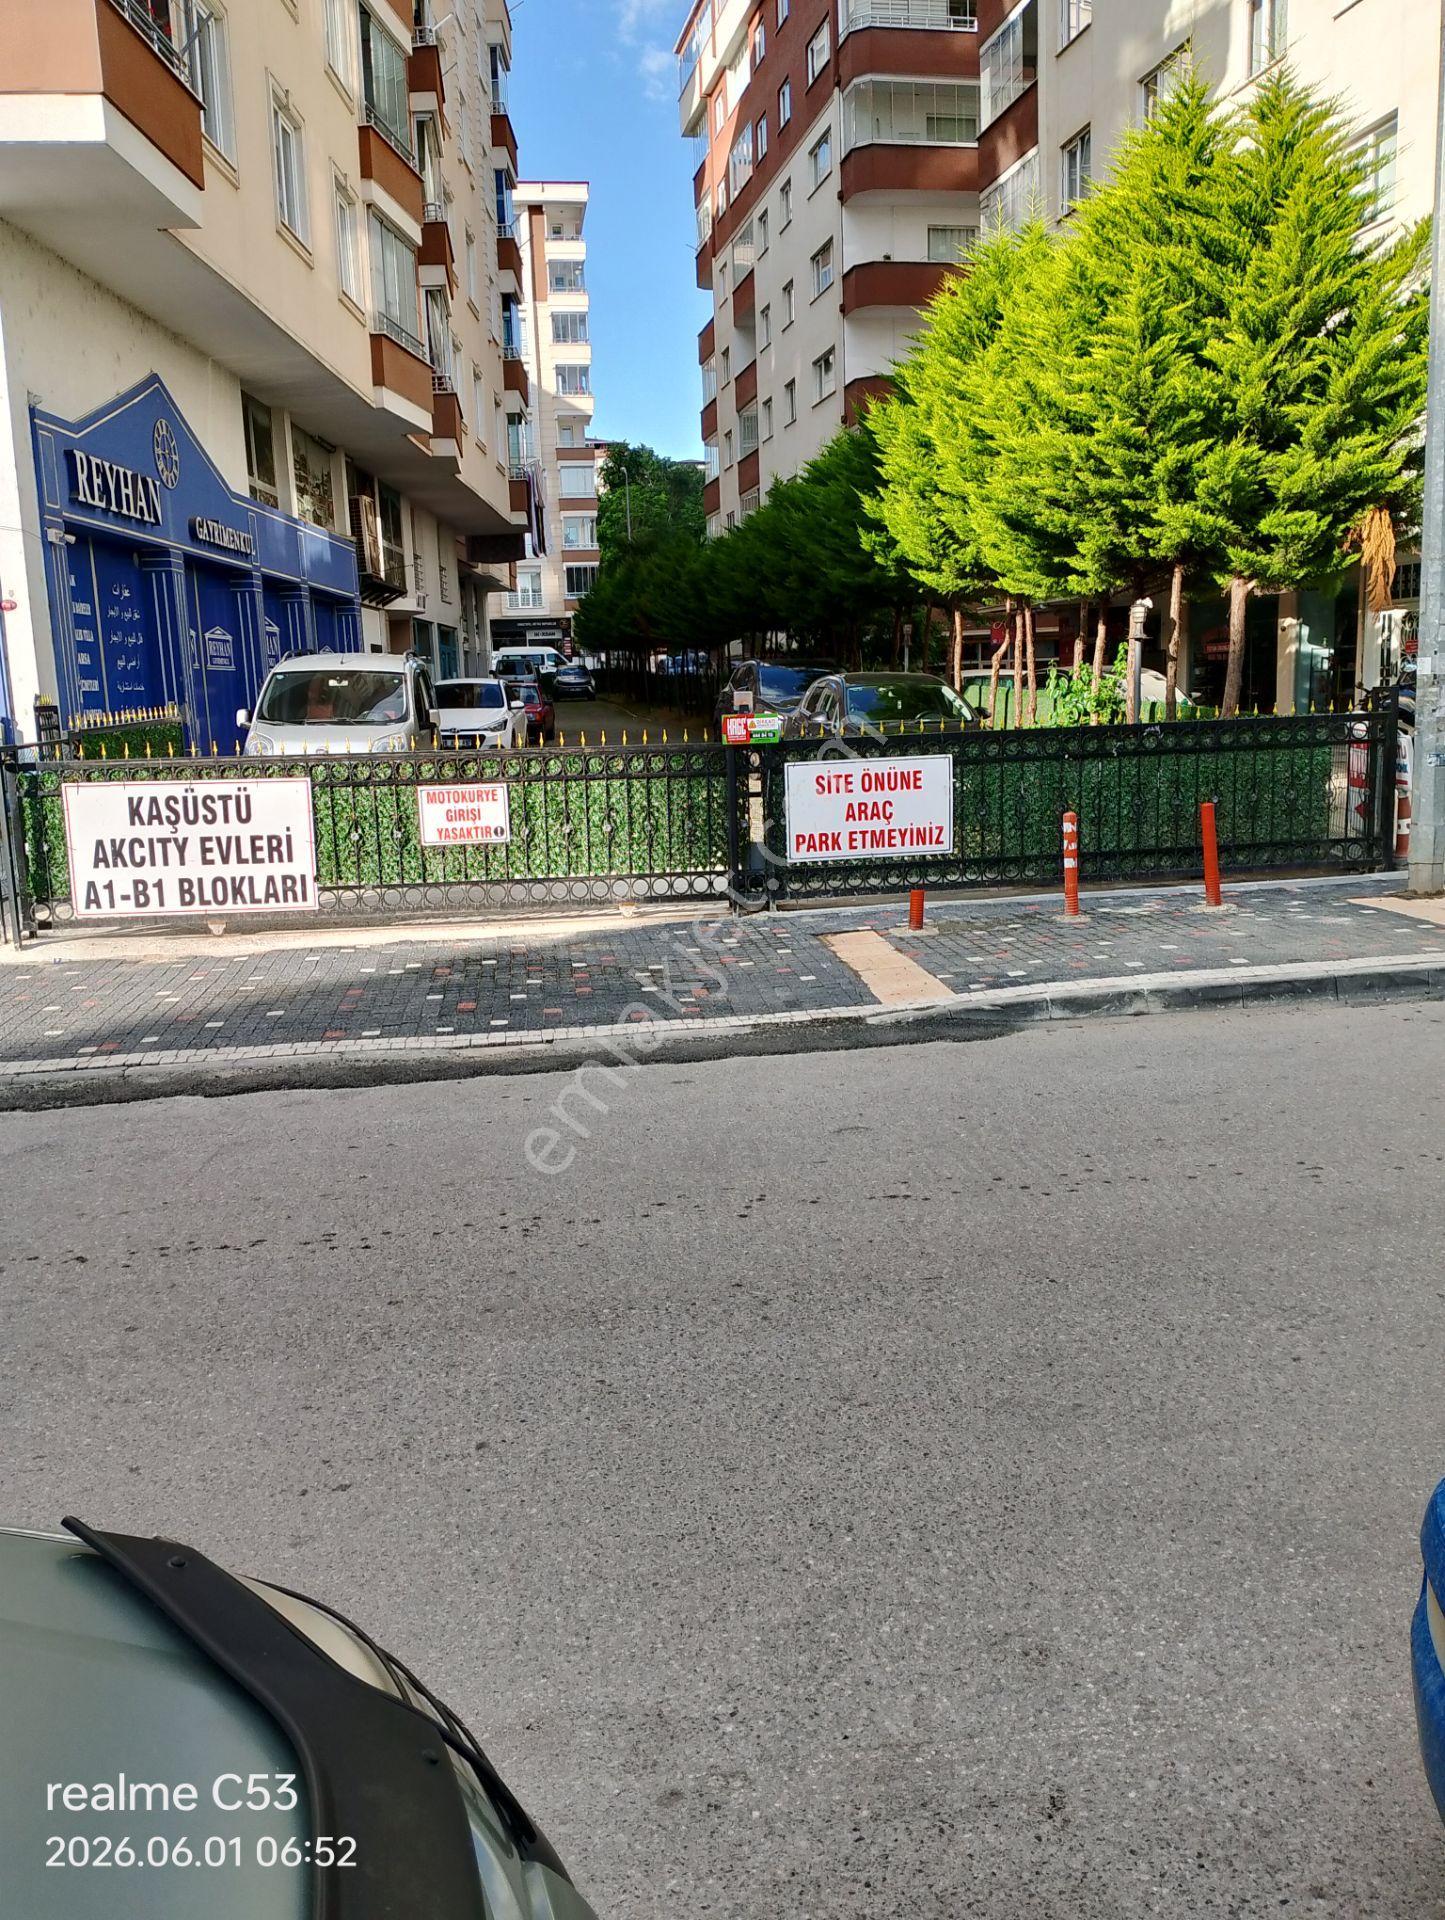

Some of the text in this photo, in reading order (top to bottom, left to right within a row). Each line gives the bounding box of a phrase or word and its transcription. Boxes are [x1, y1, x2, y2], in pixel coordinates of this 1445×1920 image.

[73, 449, 162, 526] REYHAN
[195, 516, 256, 556] GAYRİMENKUL
[426, 788, 498, 804] MOTOKURYE
[814, 766, 923, 795] SİTE ÖNÜNE
[127, 787, 252, 834] KAŞÜSTÜ
[445, 805, 481, 825] GİRİŞİ
[845, 800, 894, 826] ARAÇ
[93, 826, 294, 869] AKCITY EVLERİ
[436, 825, 493, 841] YASAKTIR
[795, 821, 945, 853] PARK ETMEYİNİZ
[84, 873, 308, 910] A1-B1 BLOKLARI
